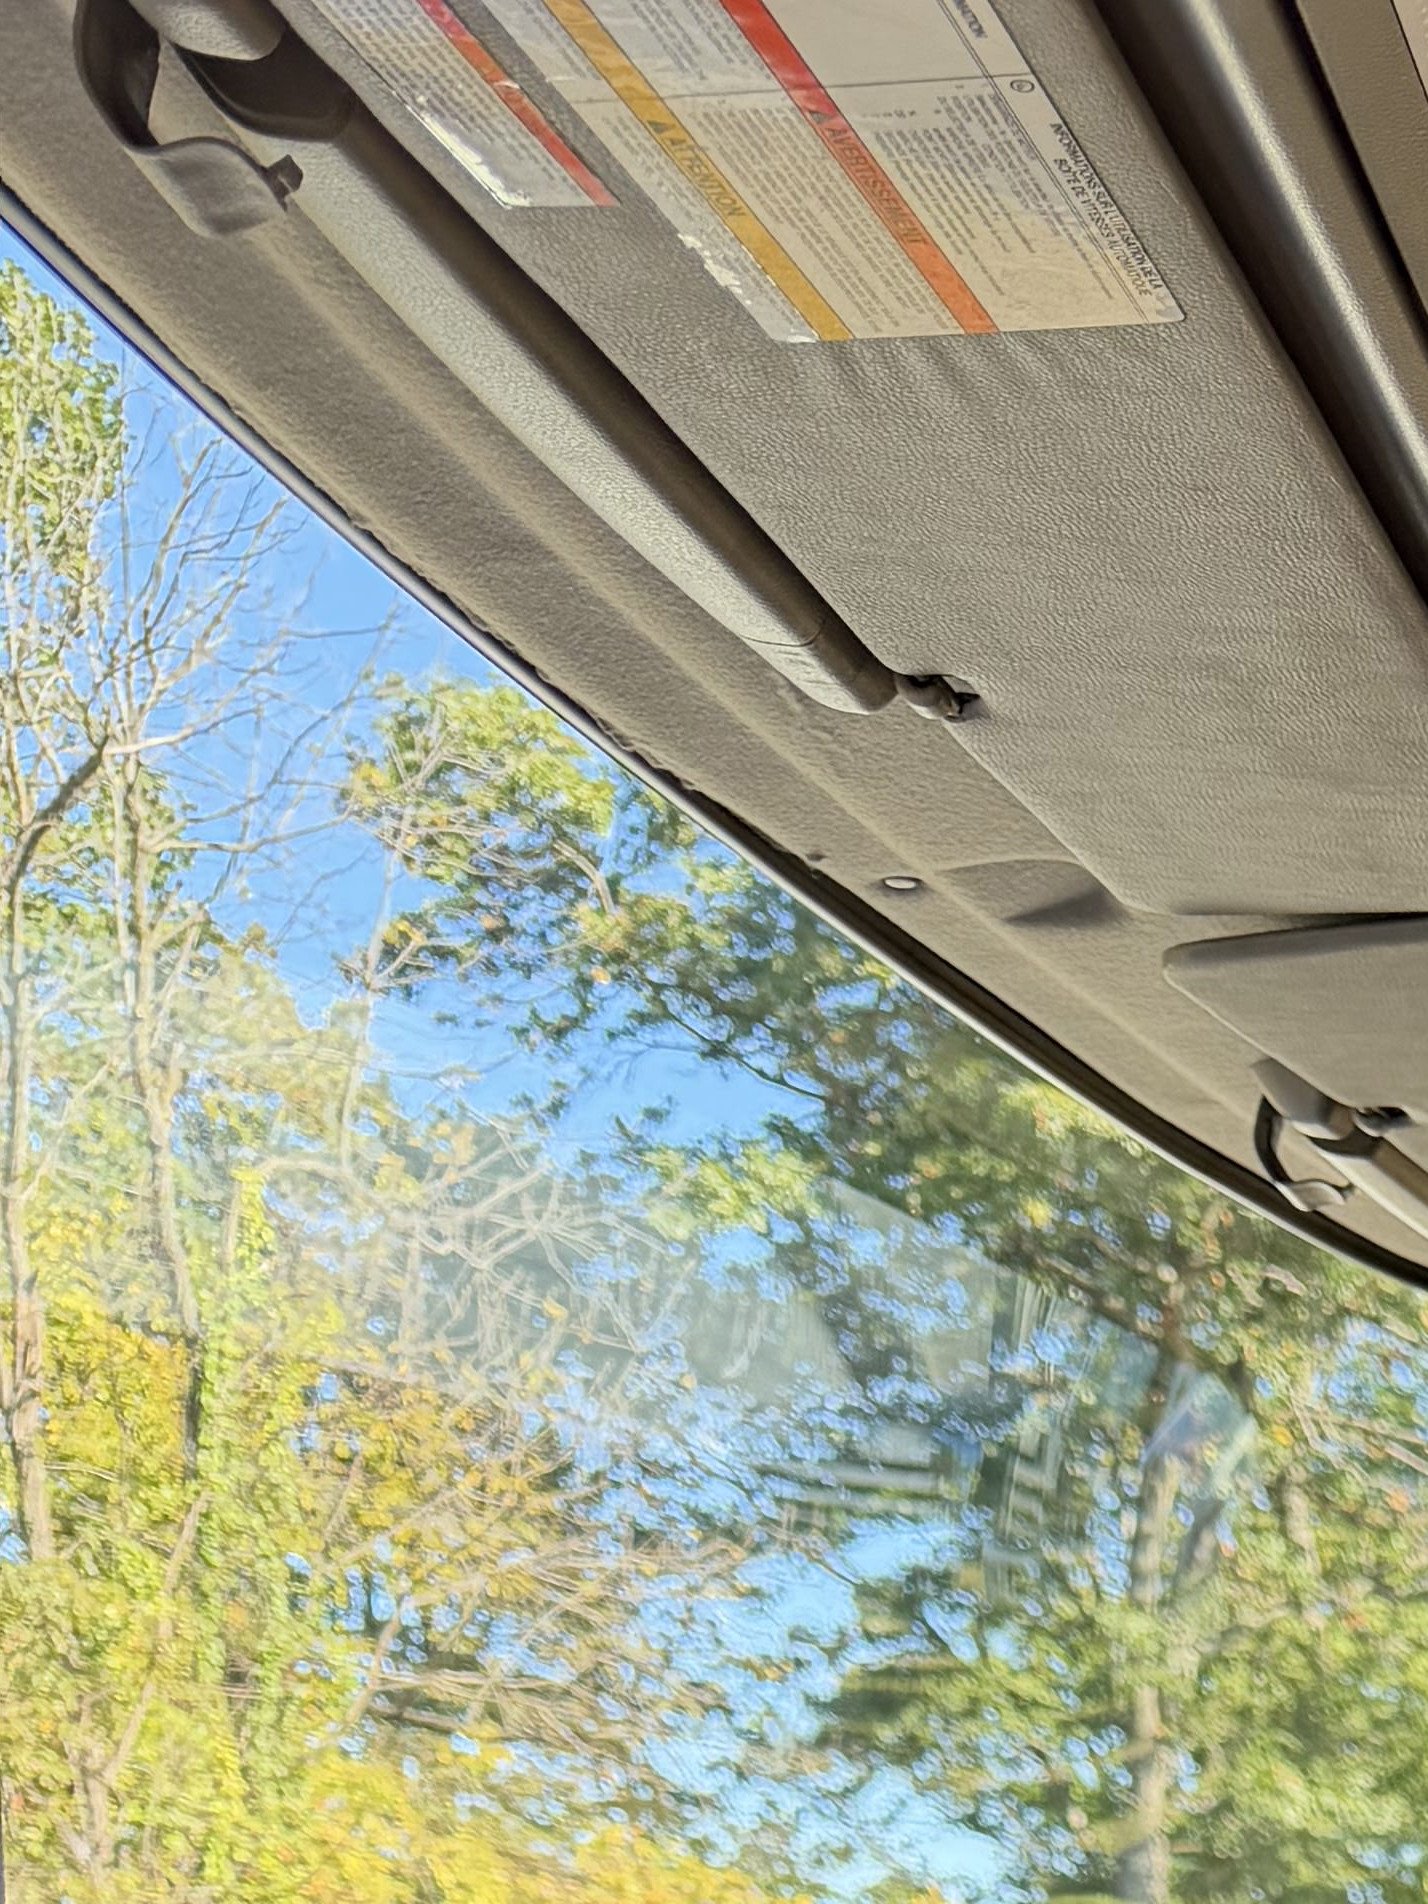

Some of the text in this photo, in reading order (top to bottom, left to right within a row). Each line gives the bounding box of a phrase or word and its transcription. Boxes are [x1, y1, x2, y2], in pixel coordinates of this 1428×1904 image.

[669, 137, 746, 218] ATTENTION
[824, 127, 929, 245] AVERTISSEMENT
[1080, 198, 1116, 239] VITESSES
